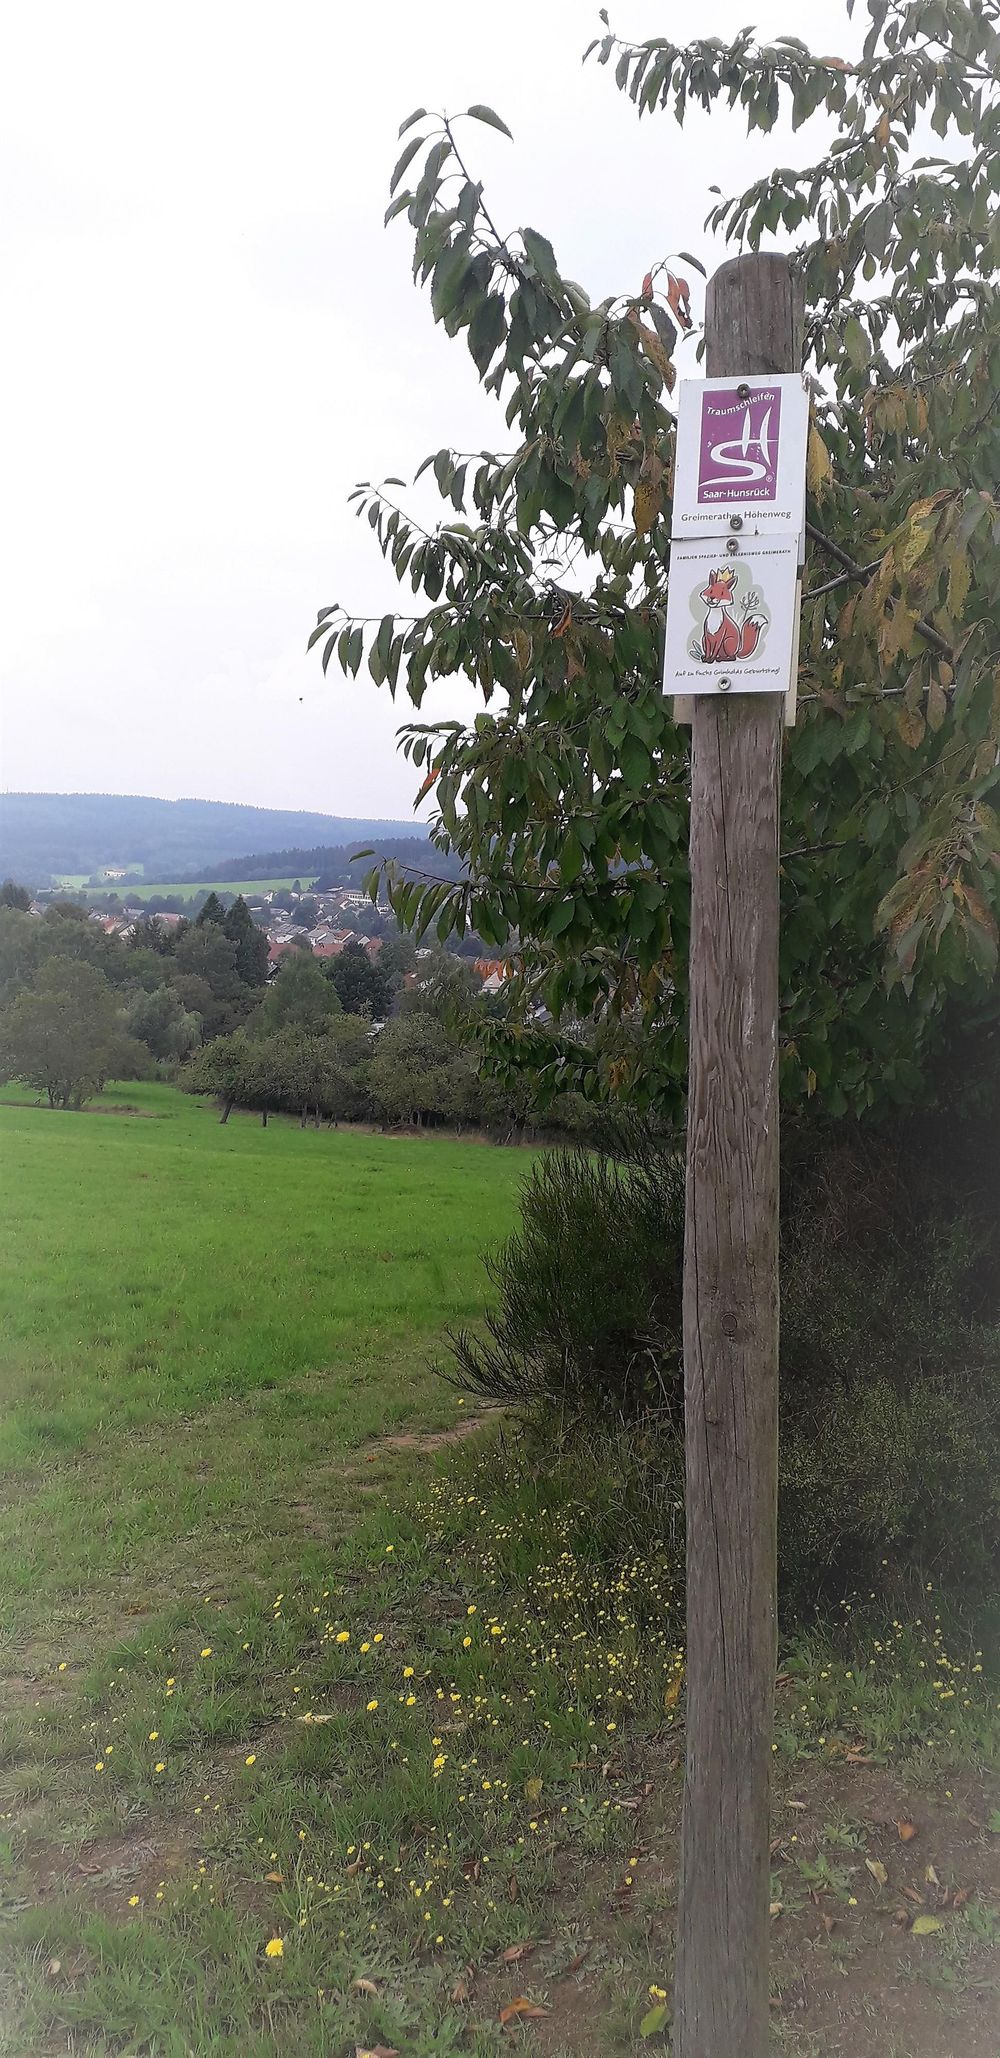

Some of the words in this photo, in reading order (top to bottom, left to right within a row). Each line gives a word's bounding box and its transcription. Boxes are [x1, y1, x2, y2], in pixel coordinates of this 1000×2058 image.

[707, 392, 775, 416] Traumschleifen
[703, 487, 770, 499] Saar-Hunsrück
[744, 511, 792, 519] Höhenweg
